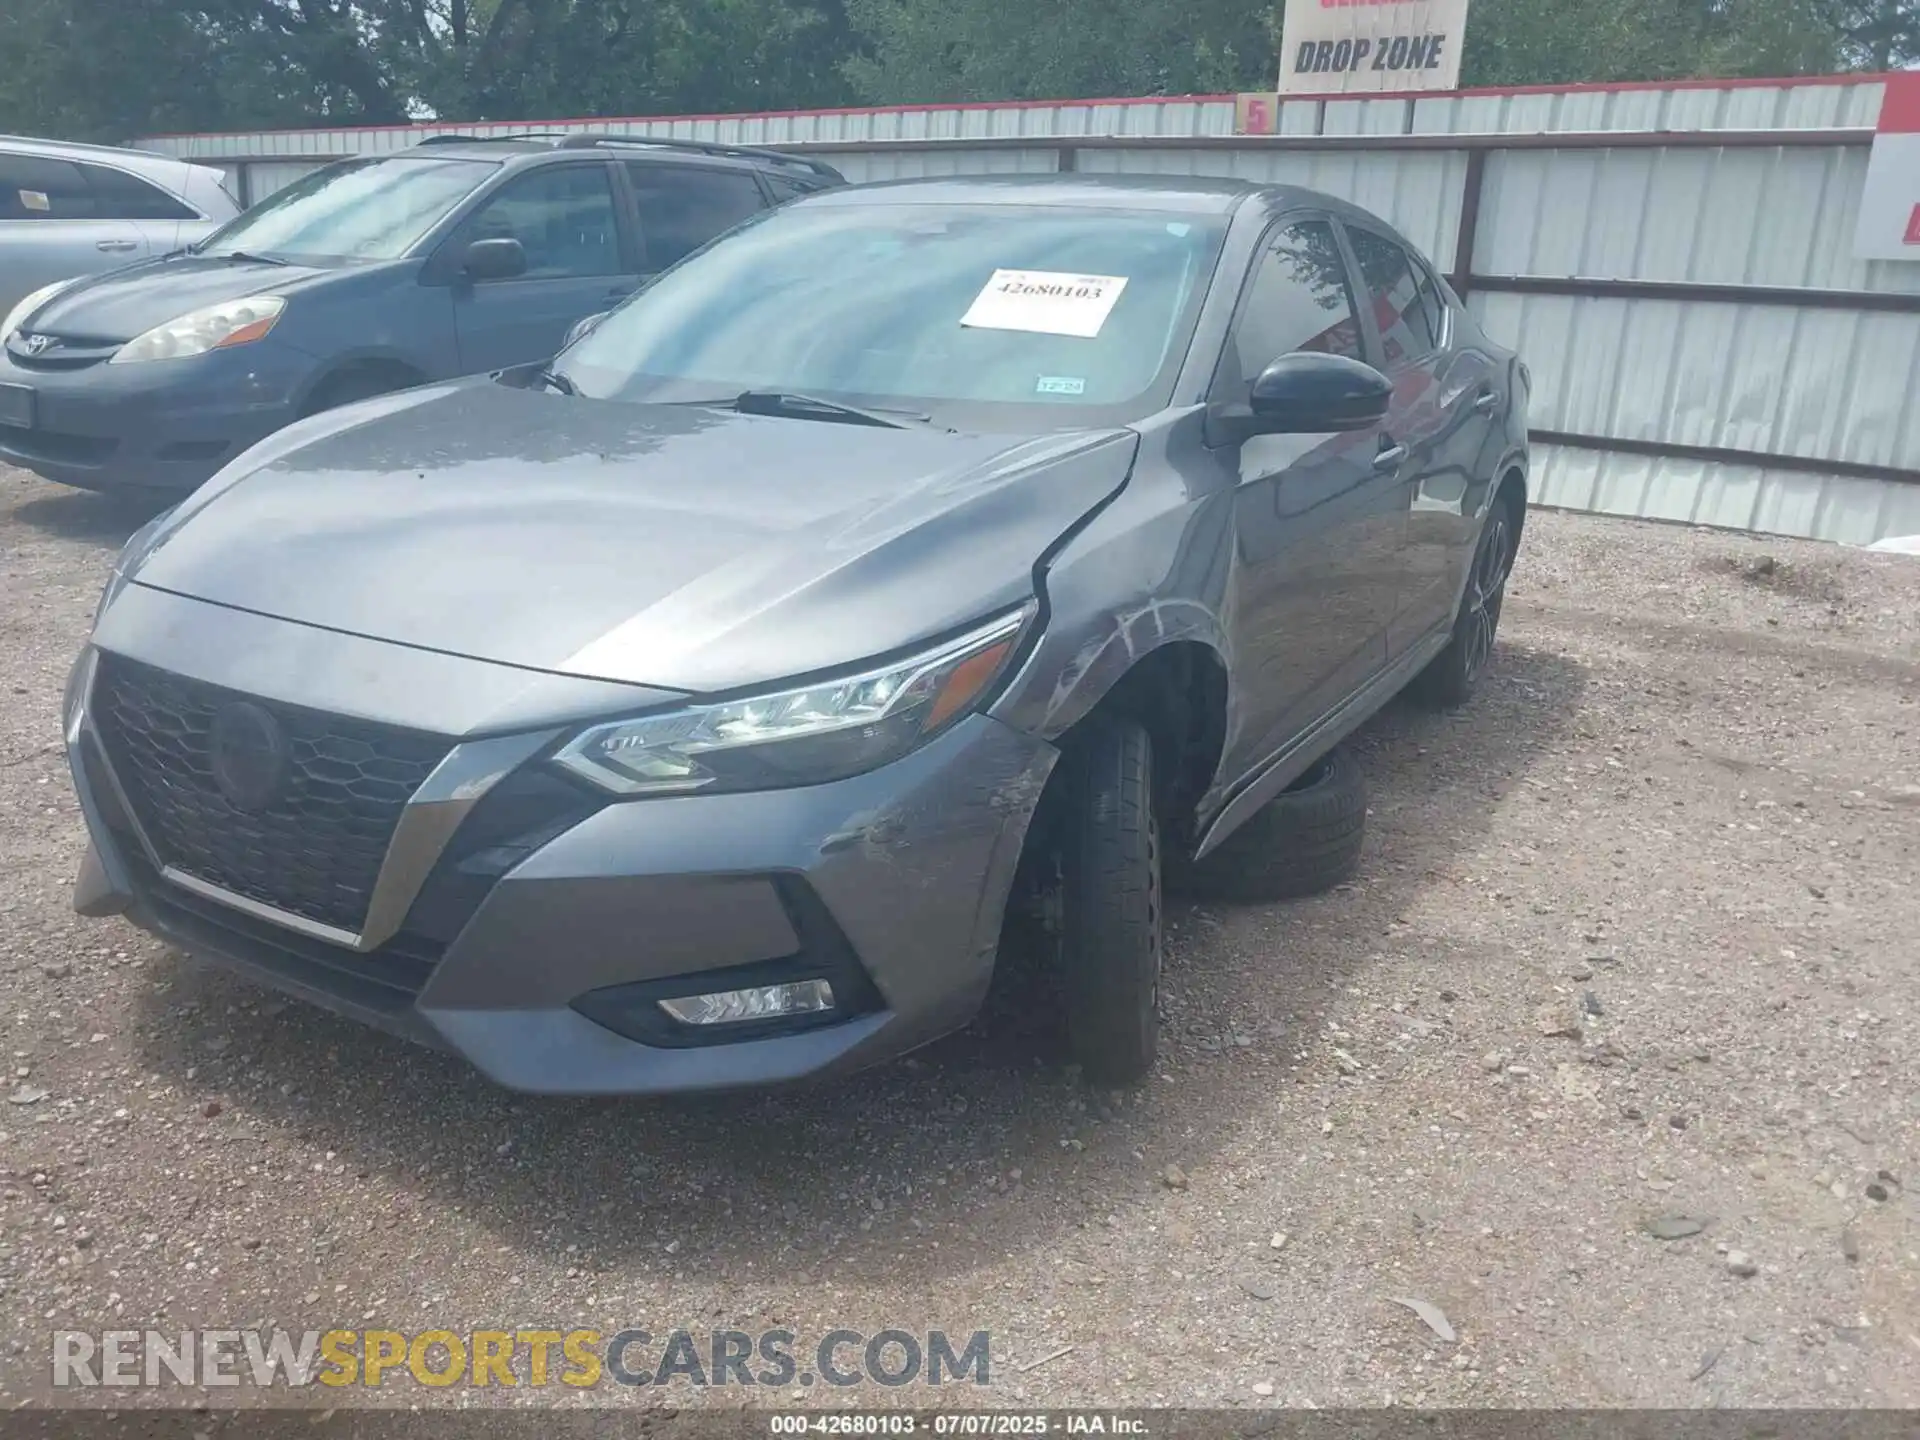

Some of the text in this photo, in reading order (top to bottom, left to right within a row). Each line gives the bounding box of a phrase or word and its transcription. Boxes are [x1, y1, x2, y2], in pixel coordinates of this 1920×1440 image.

[1294, 34, 1446, 73] DROP ZONE
[1246, 100, 1269, 134] 5
[997, 282, 1103, 300] 42680103
